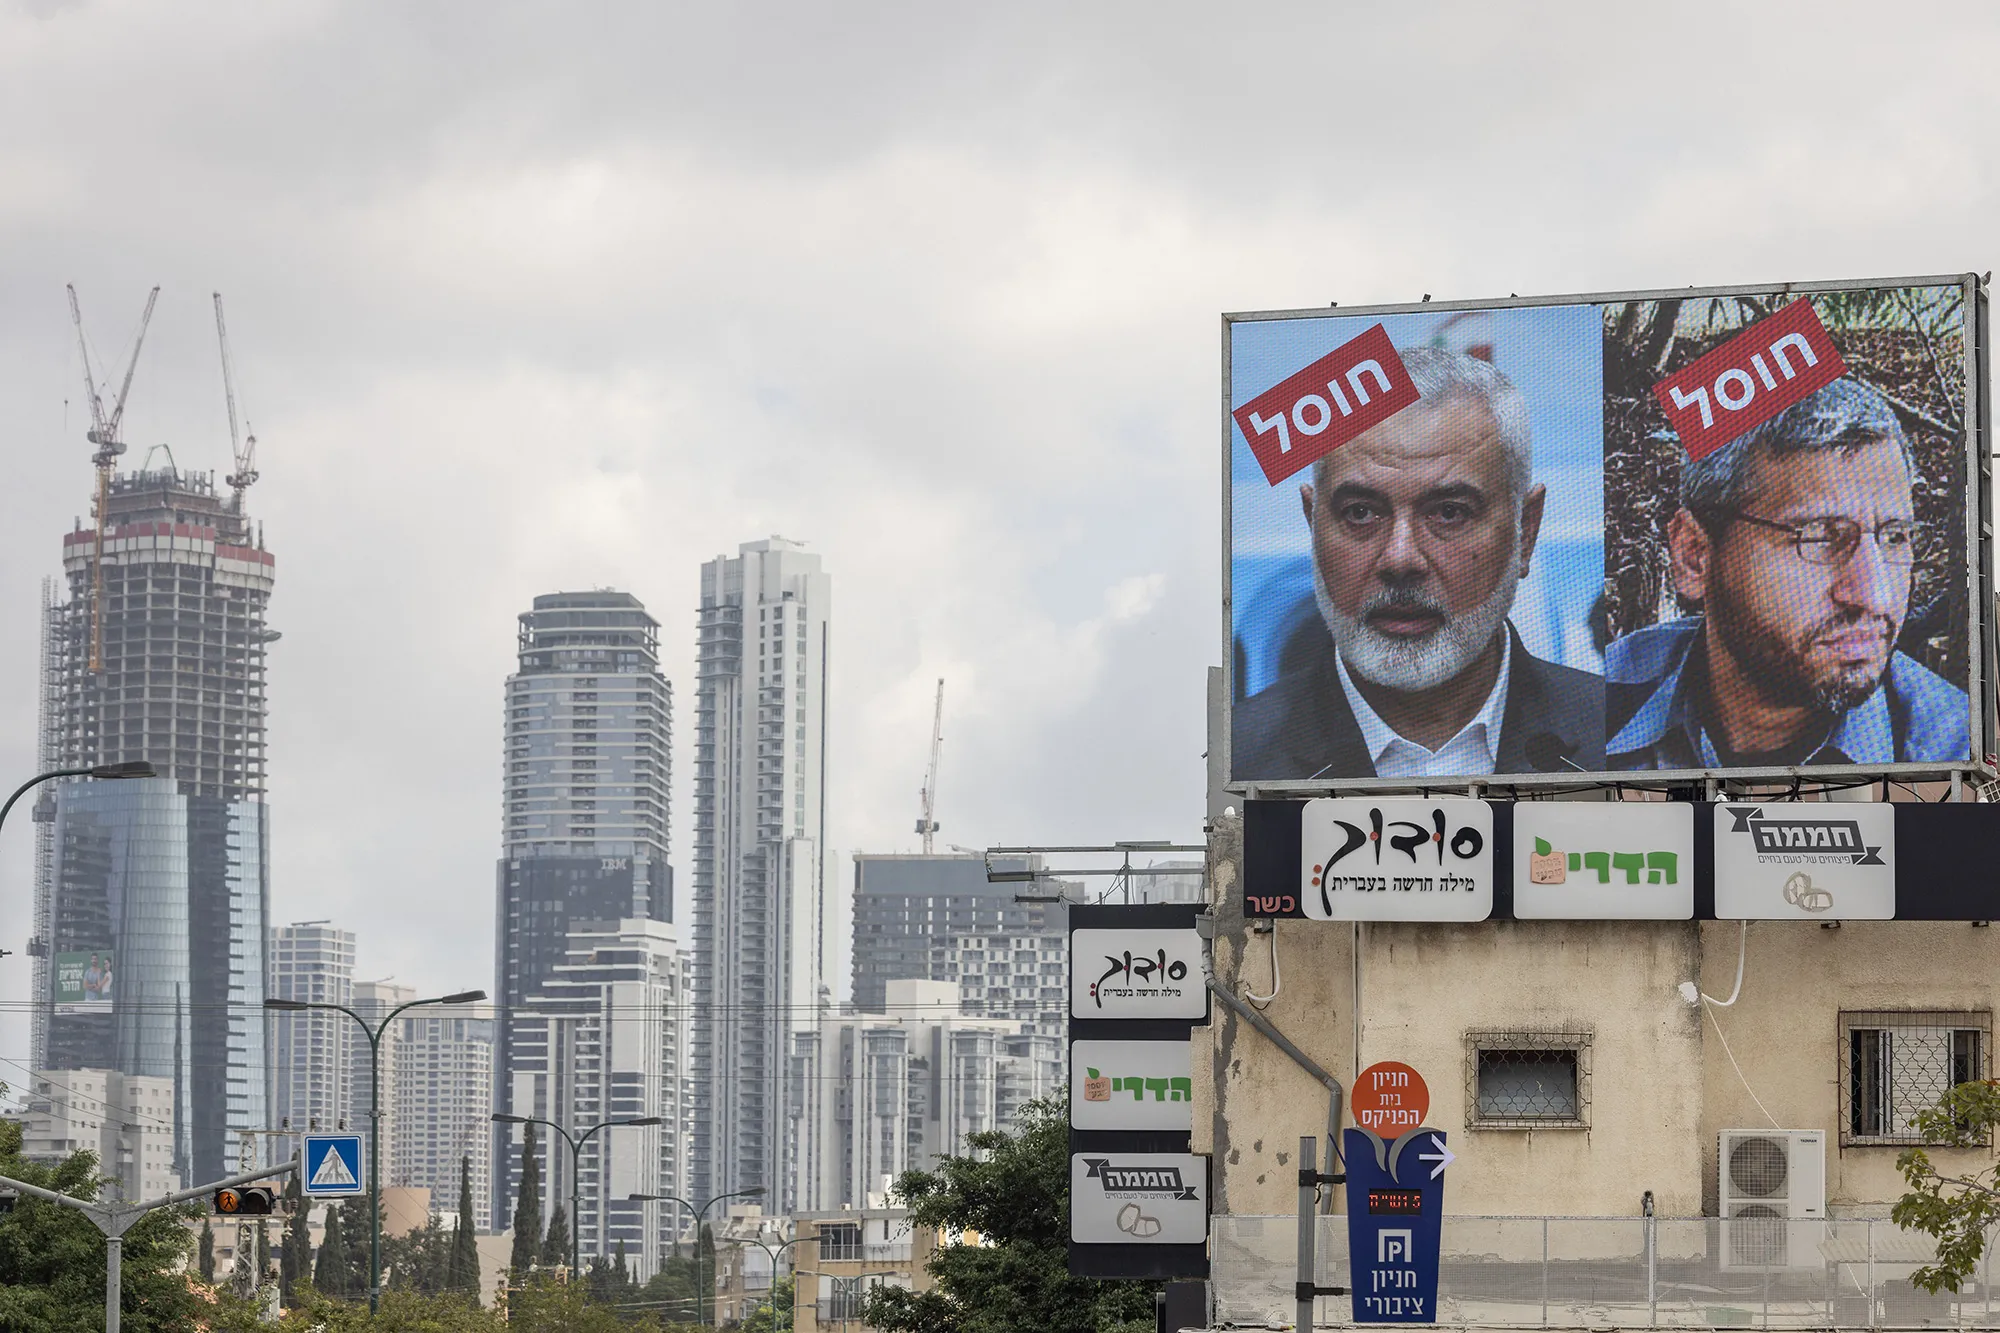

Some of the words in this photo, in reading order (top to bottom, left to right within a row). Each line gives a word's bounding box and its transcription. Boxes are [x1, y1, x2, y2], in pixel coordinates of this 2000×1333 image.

[1669, 333, 1819, 430] חוסל
[1248, 359, 1393, 454] חוסל
[1760, 826, 1855, 847] חממה
[602, 858, 627, 870] IBM
[1758, 855, 1781, 864] בחיים
[1783, 855, 1802, 864] טעם
[1803, 854, 1817, 864] של
[1818, 855, 1851, 864] פיצוחים
[1568, 851, 1678, 885] הדרי
[1331, 877, 1386, 893] בעברית
[1392, 877, 1433, 892] חדשה
[1439, 872, 1475, 892] מילה
[1246, 895, 1296, 913] כשר
[1103, 989, 1134, 998] בעברית
[1136, 989, 1159, 997] חדשה
[1161, 986, 1182, 997] מילה
[1112, 1077, 1192, 1101] הדרי
[1372, 1072, 1408, 1091] חניון
[1380, 1094, 1401, 1106] בית
[1362, 1110, 1419, 1128] הפניקס
[1106, 1171, 1177, 1187] חממה
[1138, 1191, 1148, 1199] של
[1372, 1270, 1416, 1293] חניון
[1364, 1298, 1424, 1315] ציבורי
